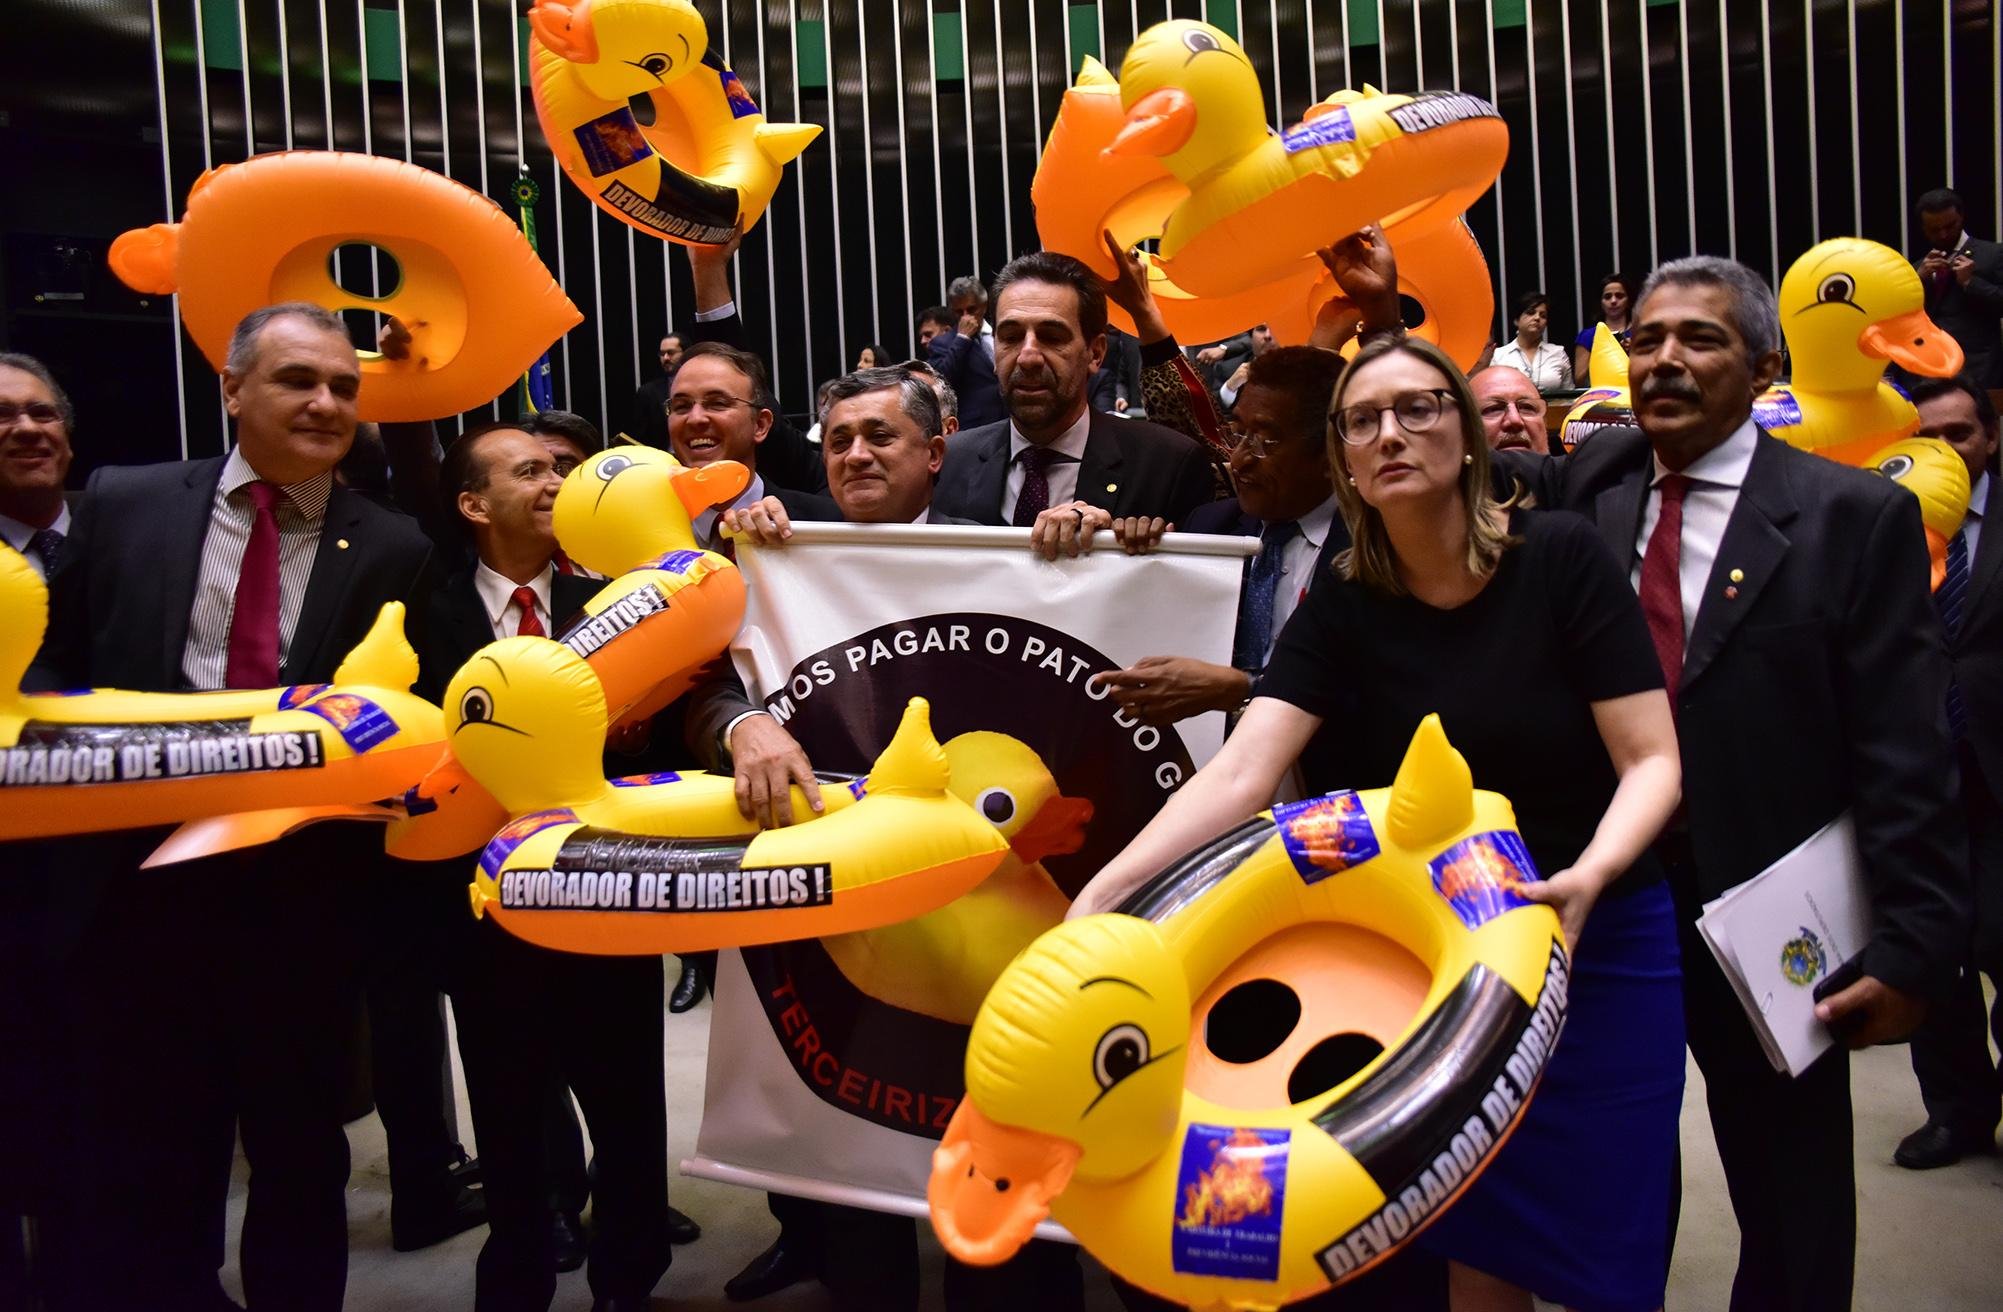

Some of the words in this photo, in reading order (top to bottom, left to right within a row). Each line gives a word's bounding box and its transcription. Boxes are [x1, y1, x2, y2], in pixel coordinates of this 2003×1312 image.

[604, 183, 690, 235] DEVORADOR
[683, 221, 705, 241] DE
[564, 584, 664, 658] IREITOS!
[767, 660, 836, 727] MOS
[845, 625, 970, 673] PAGAR
[984, 628, 1010, 655] O
[1020, 636, 1112, 701] PATO
[122, 744, 162, 779] DE
[502, 871, 632, 908] DEVORADOR
[637, 872, 671, 908] DE
[771, 974, 957, 1130] TERCEIRIZ
[1324, 1114, 1494, 1278] DEVORADOR
[1481, 1075, 1521, 1133] DE
